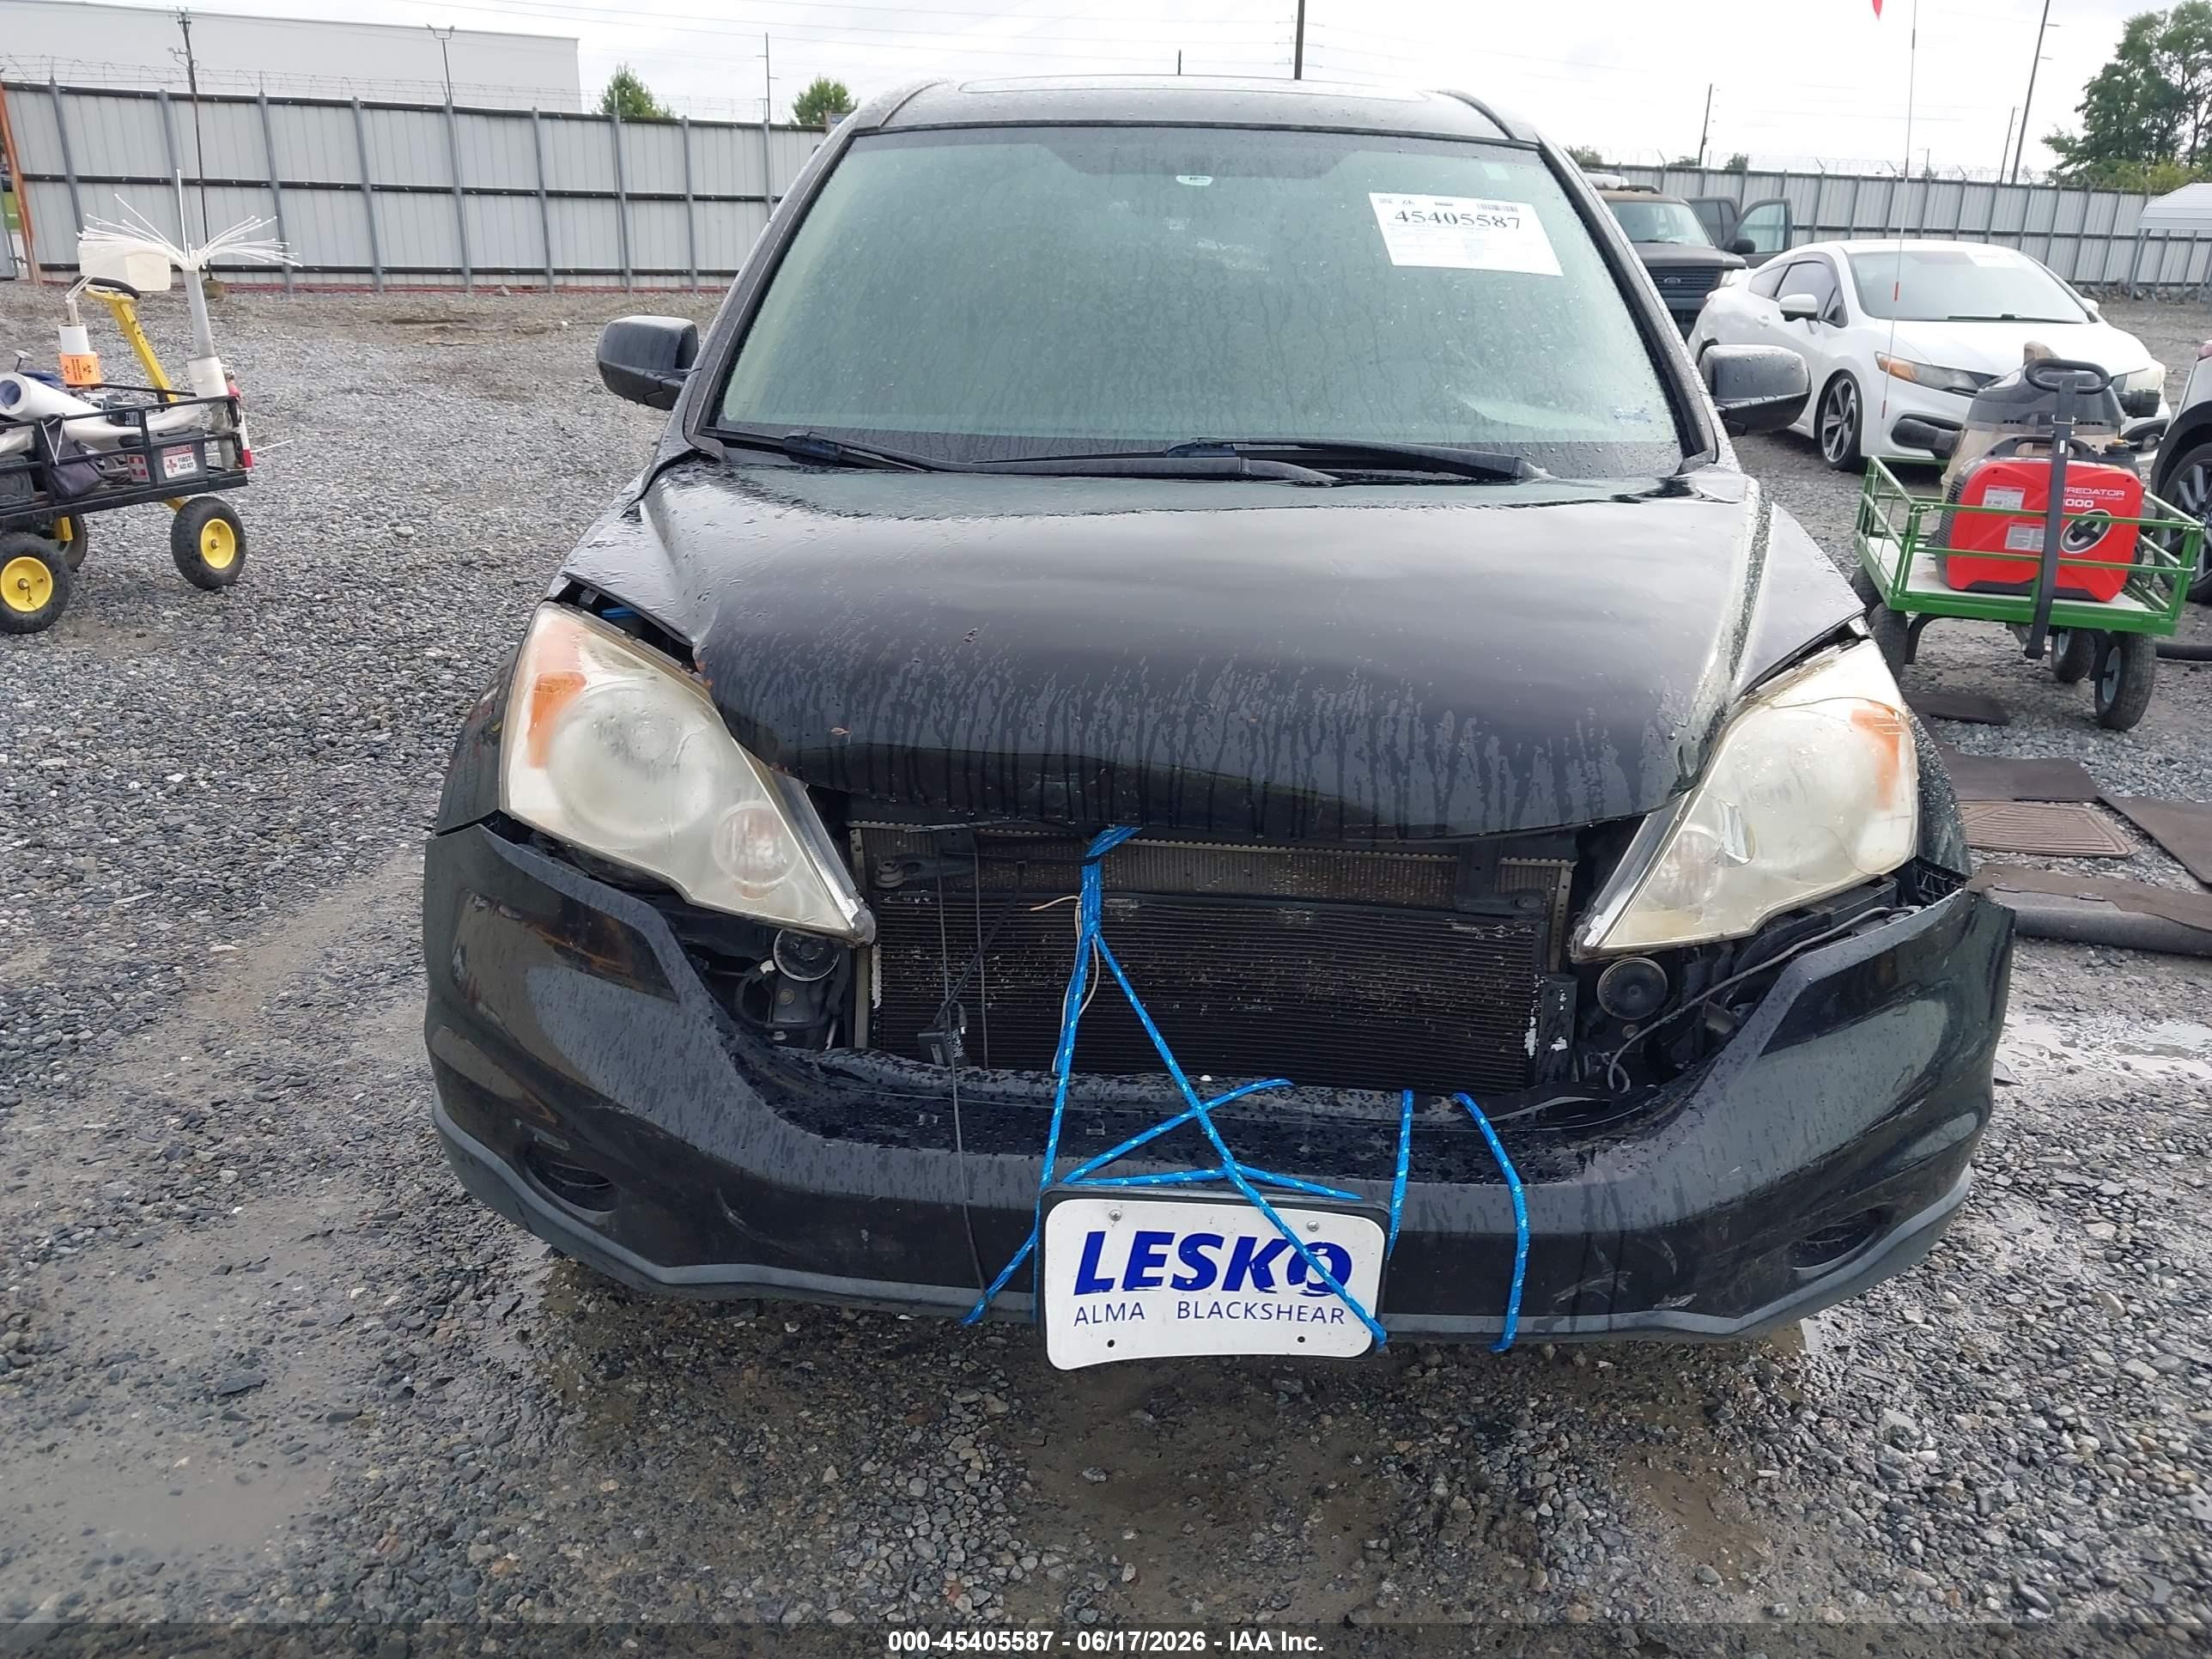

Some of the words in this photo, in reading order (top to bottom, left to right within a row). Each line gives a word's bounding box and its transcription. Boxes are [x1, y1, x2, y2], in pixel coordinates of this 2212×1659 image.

[1395, 210, 1521, 229] 45405587
[2063, 498, 2094, 508] 000
[1073, 1230, 1353, 1297] LESKO
[1073, 1302, 1146, 1327] ALMA
[1177, 1300, 1346, 1325] BLACKSHEAR
